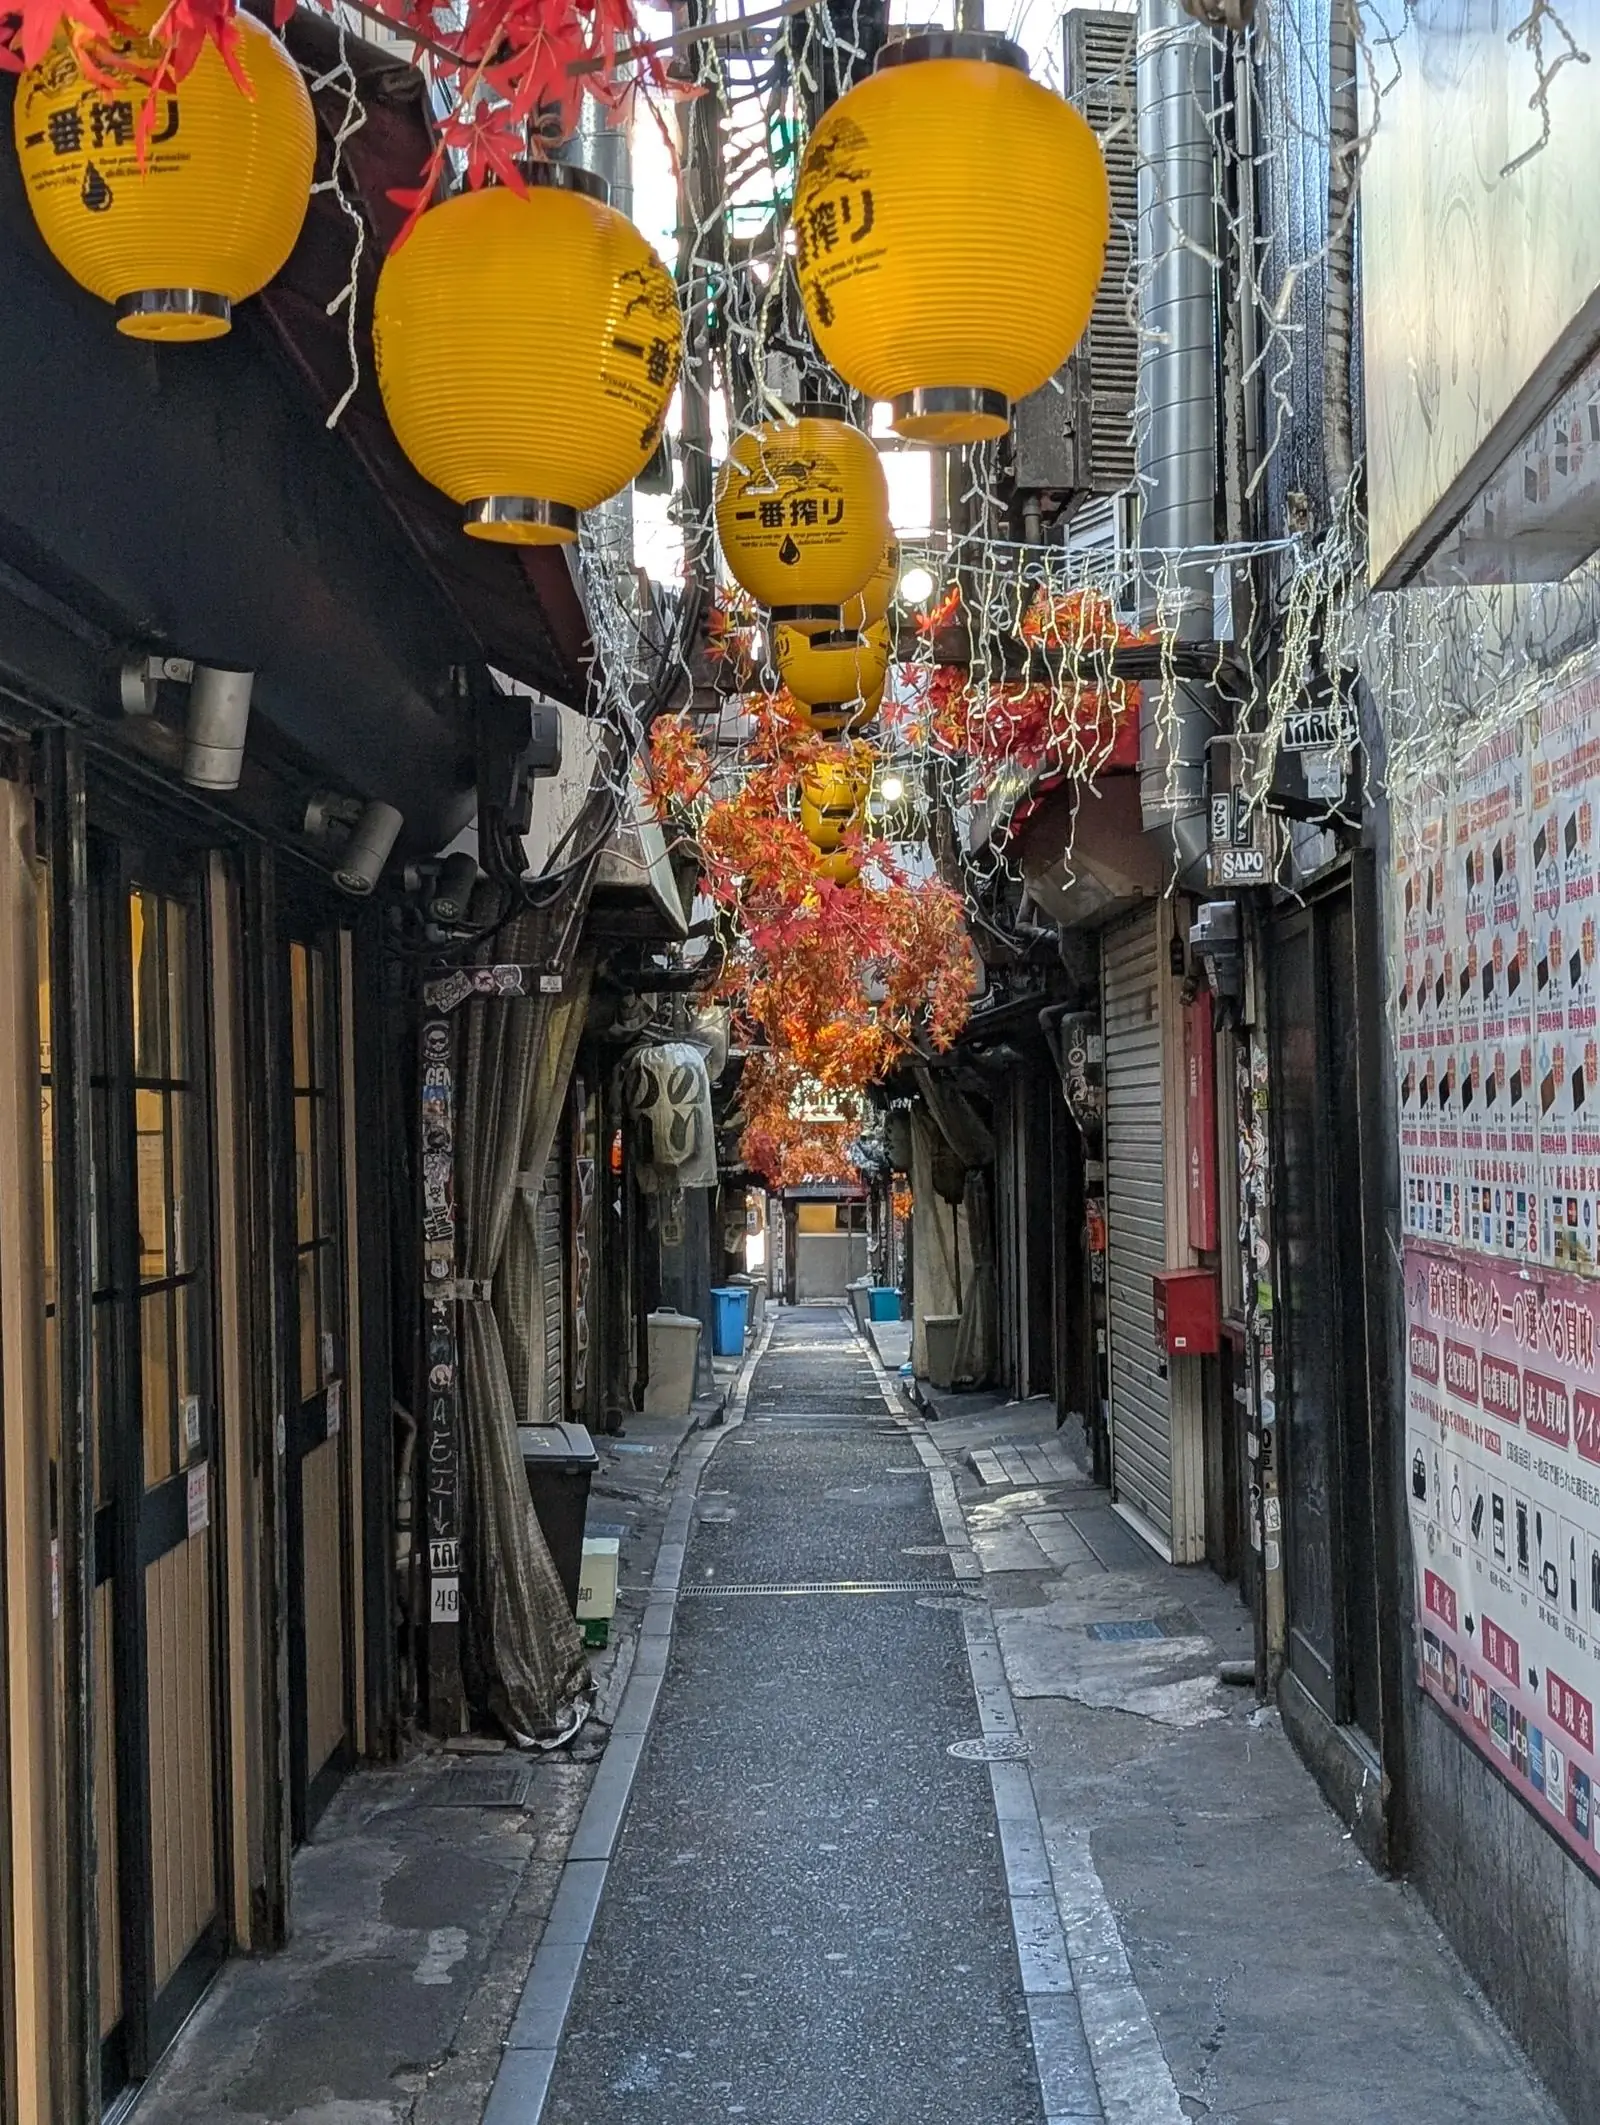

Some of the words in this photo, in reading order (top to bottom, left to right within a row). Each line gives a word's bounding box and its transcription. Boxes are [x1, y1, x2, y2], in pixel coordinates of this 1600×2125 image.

[735, 496, 845, 528] 一番搾り
[1222, 851, 1263, 879] SAPO
[1483, 1365, 1520, 1412] 出張買取
[1526, 1386, 1567, 1435] 法人買取
[1488, 1625, 1512, 1676] 買取
[1551, 1677, 1588, 1744] 即現金
[1511, 1723, 1528, 1757] JCB
